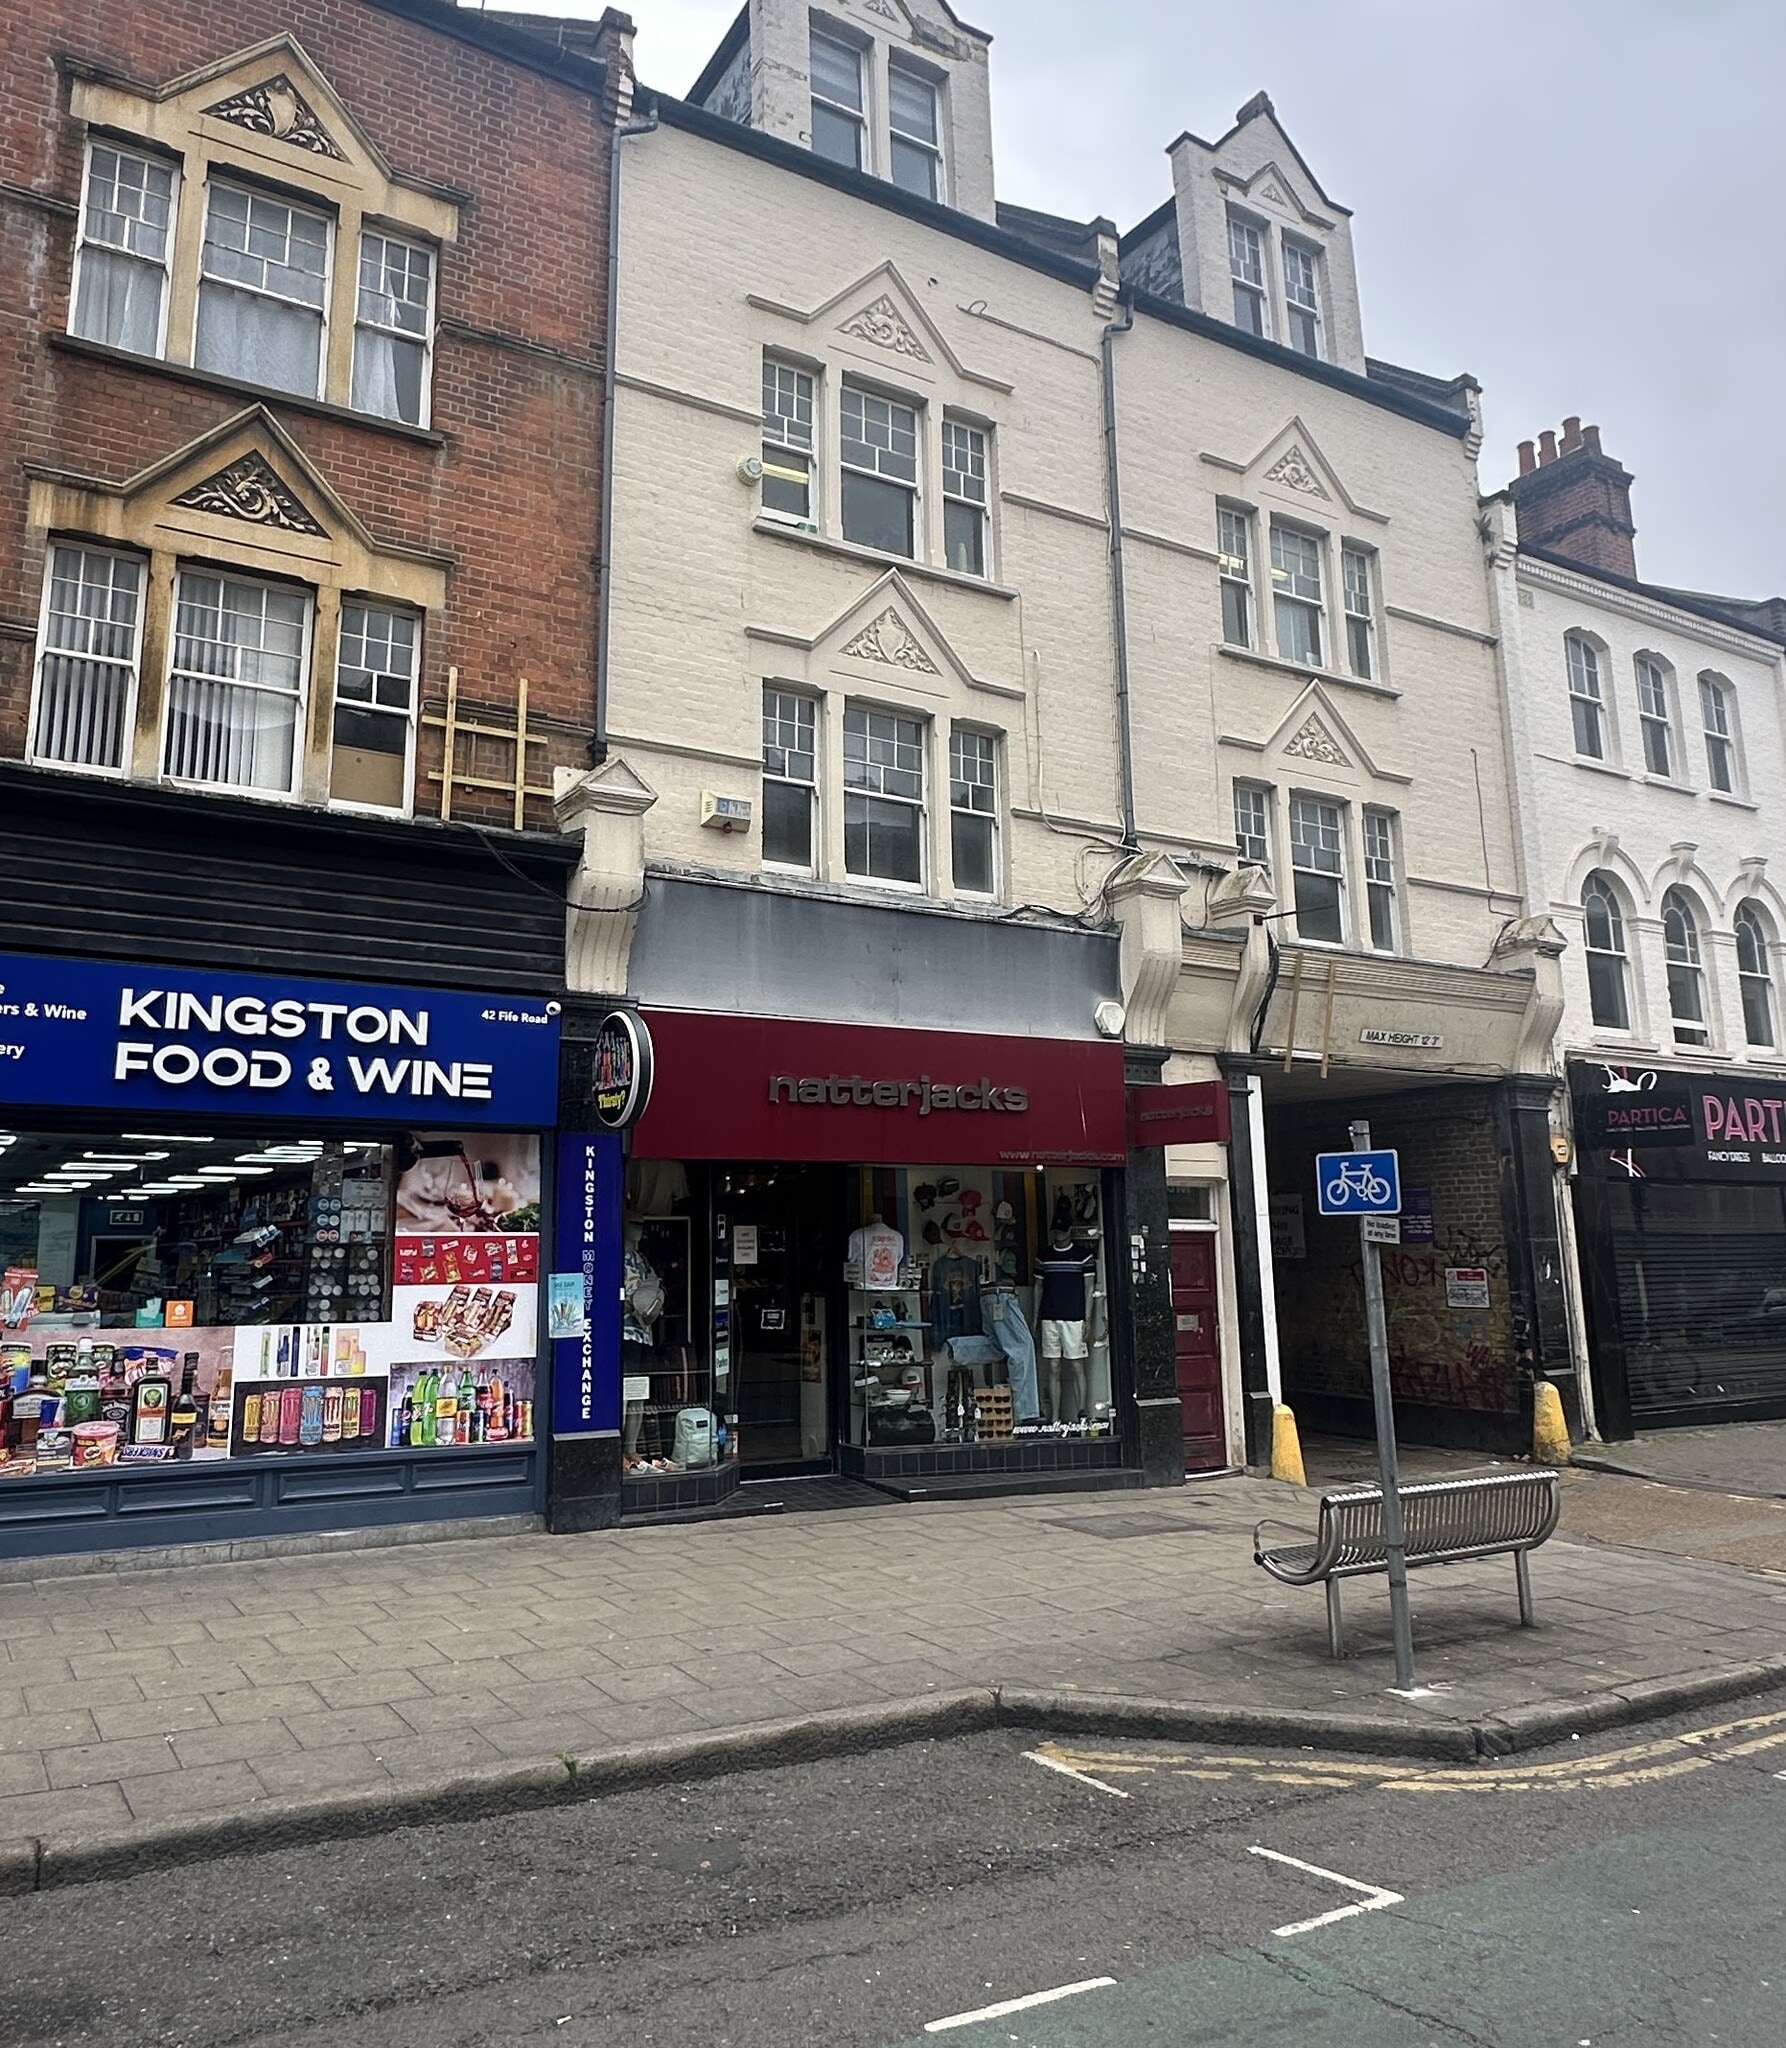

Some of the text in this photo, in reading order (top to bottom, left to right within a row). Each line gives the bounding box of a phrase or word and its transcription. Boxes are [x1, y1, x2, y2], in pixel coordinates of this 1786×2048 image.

[24, 1002, 39, 1017] &
[43, 1003, 87, 1020] Wine
[119, 988, 429, 1046] KINGSTON
[481, 1009, 548, 1024] 42 Fife Road
[1366, 1030, 1387, 1042] MAX
[1388, 1033, 1420, 1045] HEIGHT
[114, 1042, 493, 1099] FOOD & WINE
[598, 1090, 626, 1110] Thirsty?
[769, 1074, 1029, 1115] natterjacks
[1608, 1107, 1687, 1125] PARTICA
[1702, 1095, 1786, 1143] PART
[1366, 1220, 1375, 1228] No
[1376, 1221, 1396, 1231] loading
[581, 1145, 595, 1420] KINGSTON MONEY EXCHANGE
